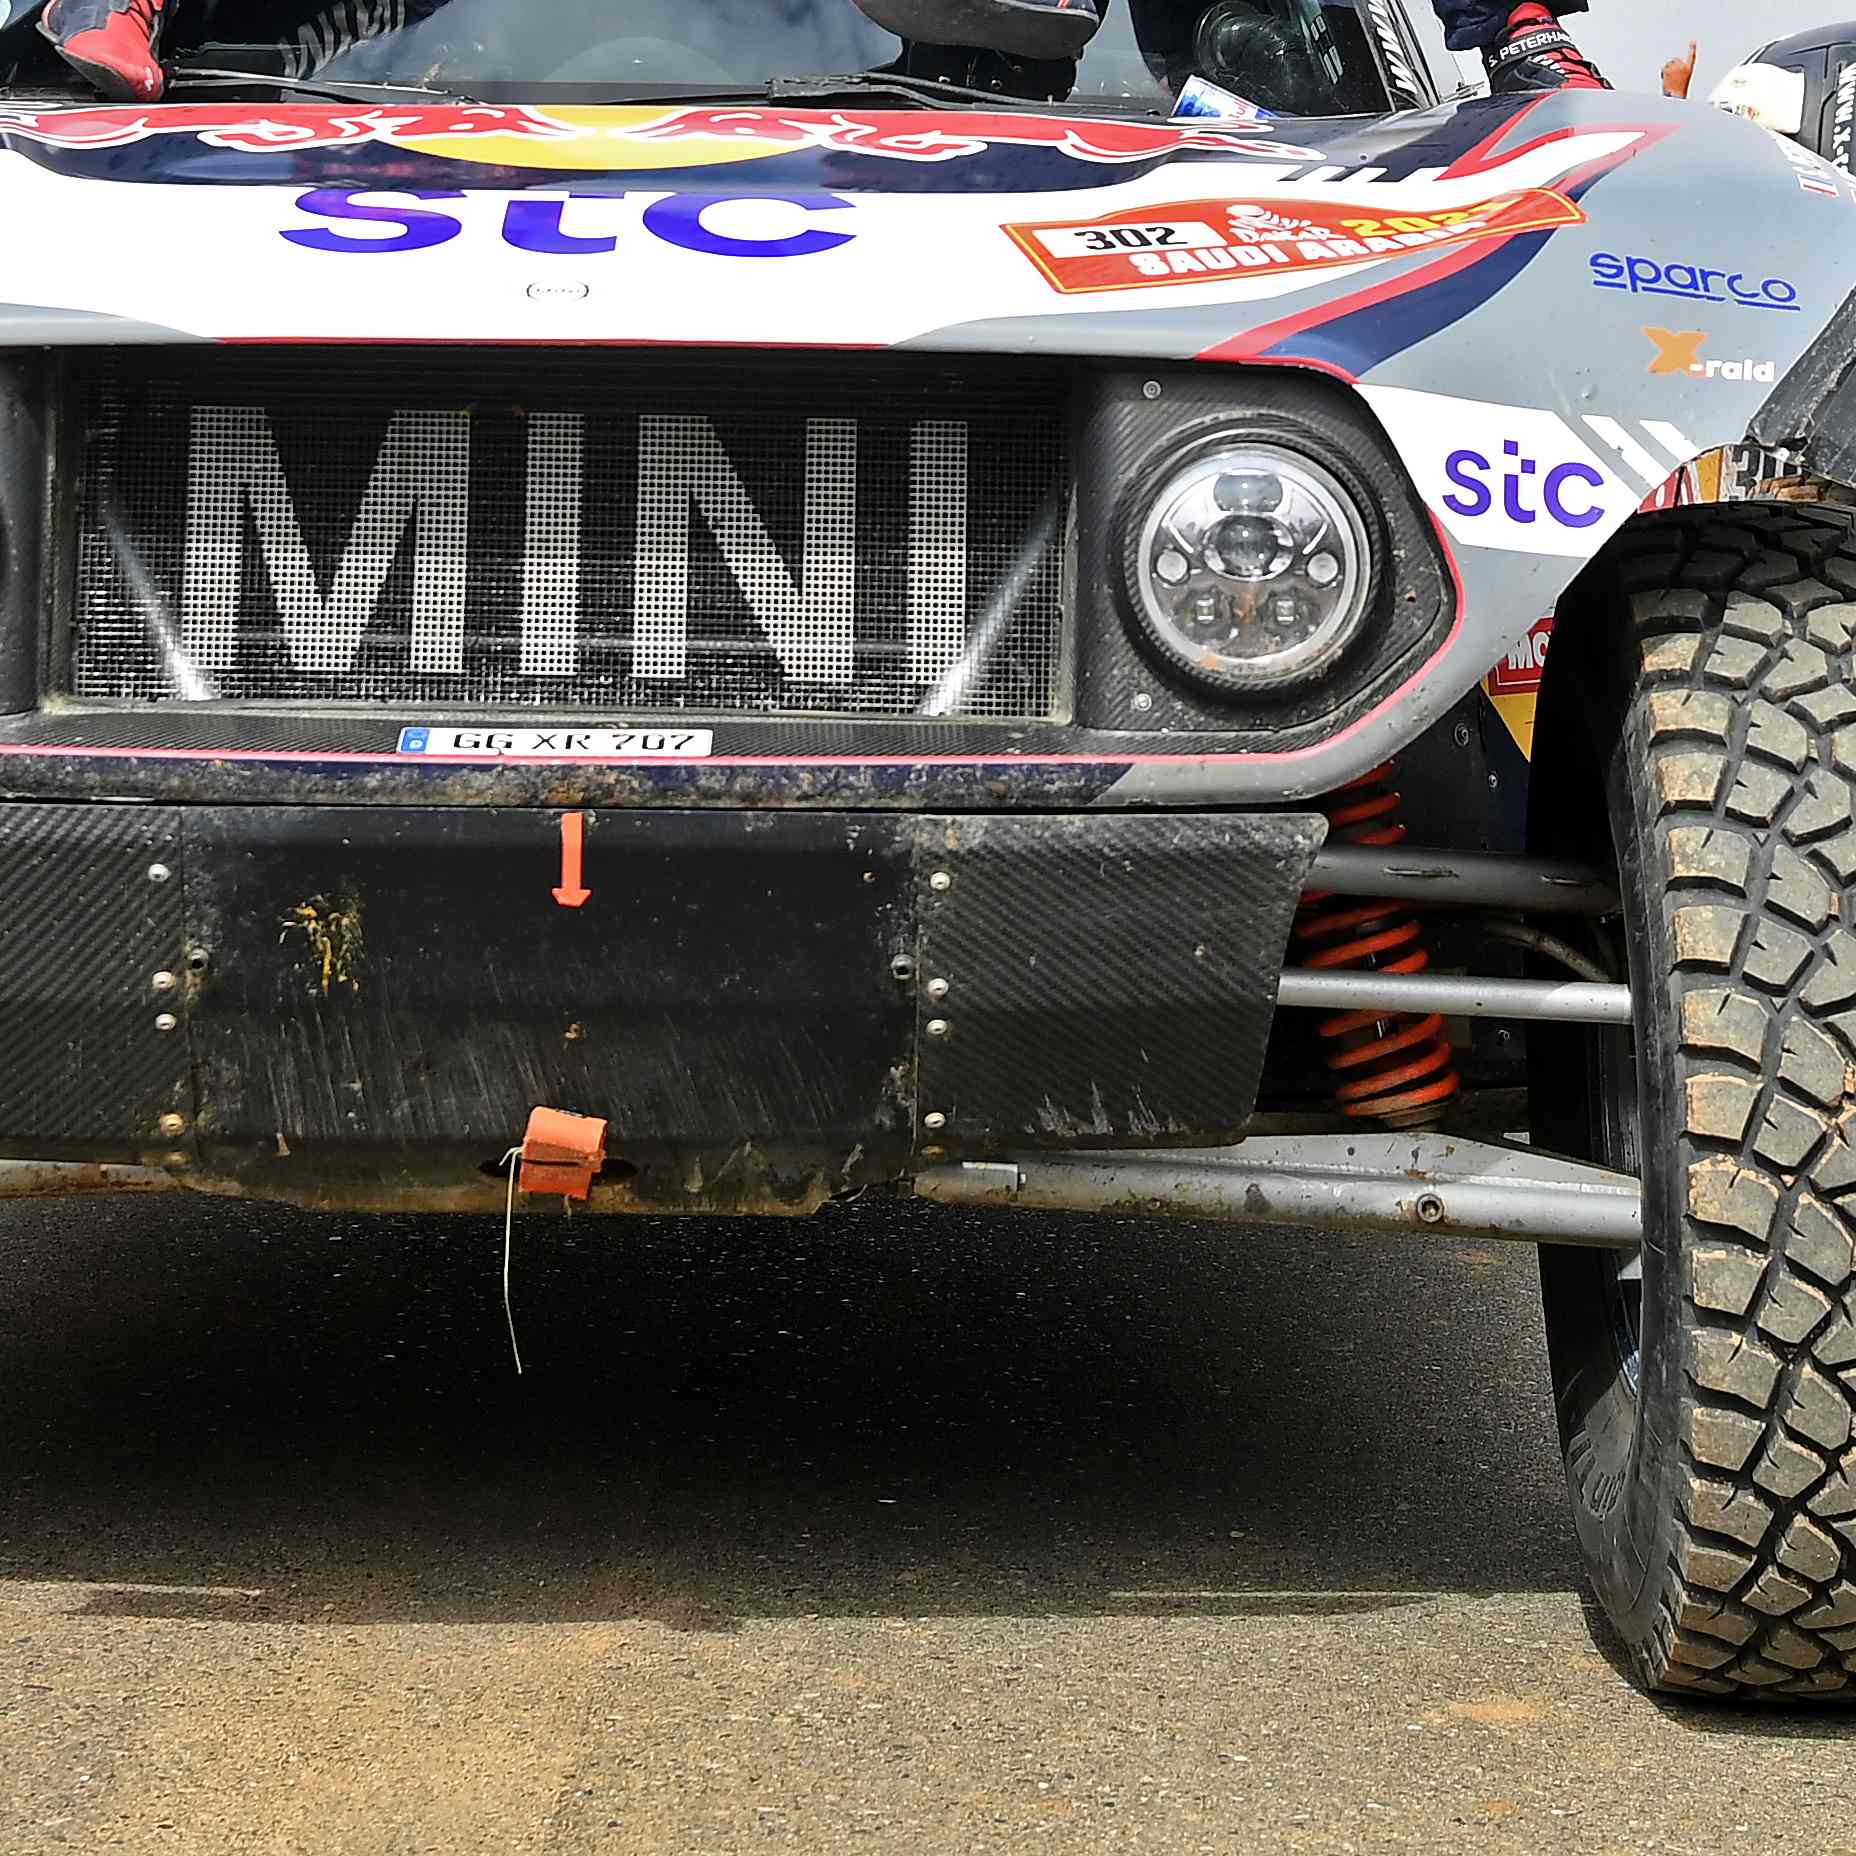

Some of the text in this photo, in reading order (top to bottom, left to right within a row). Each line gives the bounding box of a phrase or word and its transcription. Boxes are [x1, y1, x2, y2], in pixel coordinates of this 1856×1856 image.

[1500, 31, 1569, 61] PETERHA
[278, 187, 857, 258] stc
[1073, 225, 1189, 251] 302
[1129, 221, 1489, 277] SAUDI ARABIA
[1590, 250, 1802, 310] sparco
[1442, 438, 1605, 528] stc
[182, 404, 968, 685] MINI
[452, 730, 695, 753] GG XR 707
